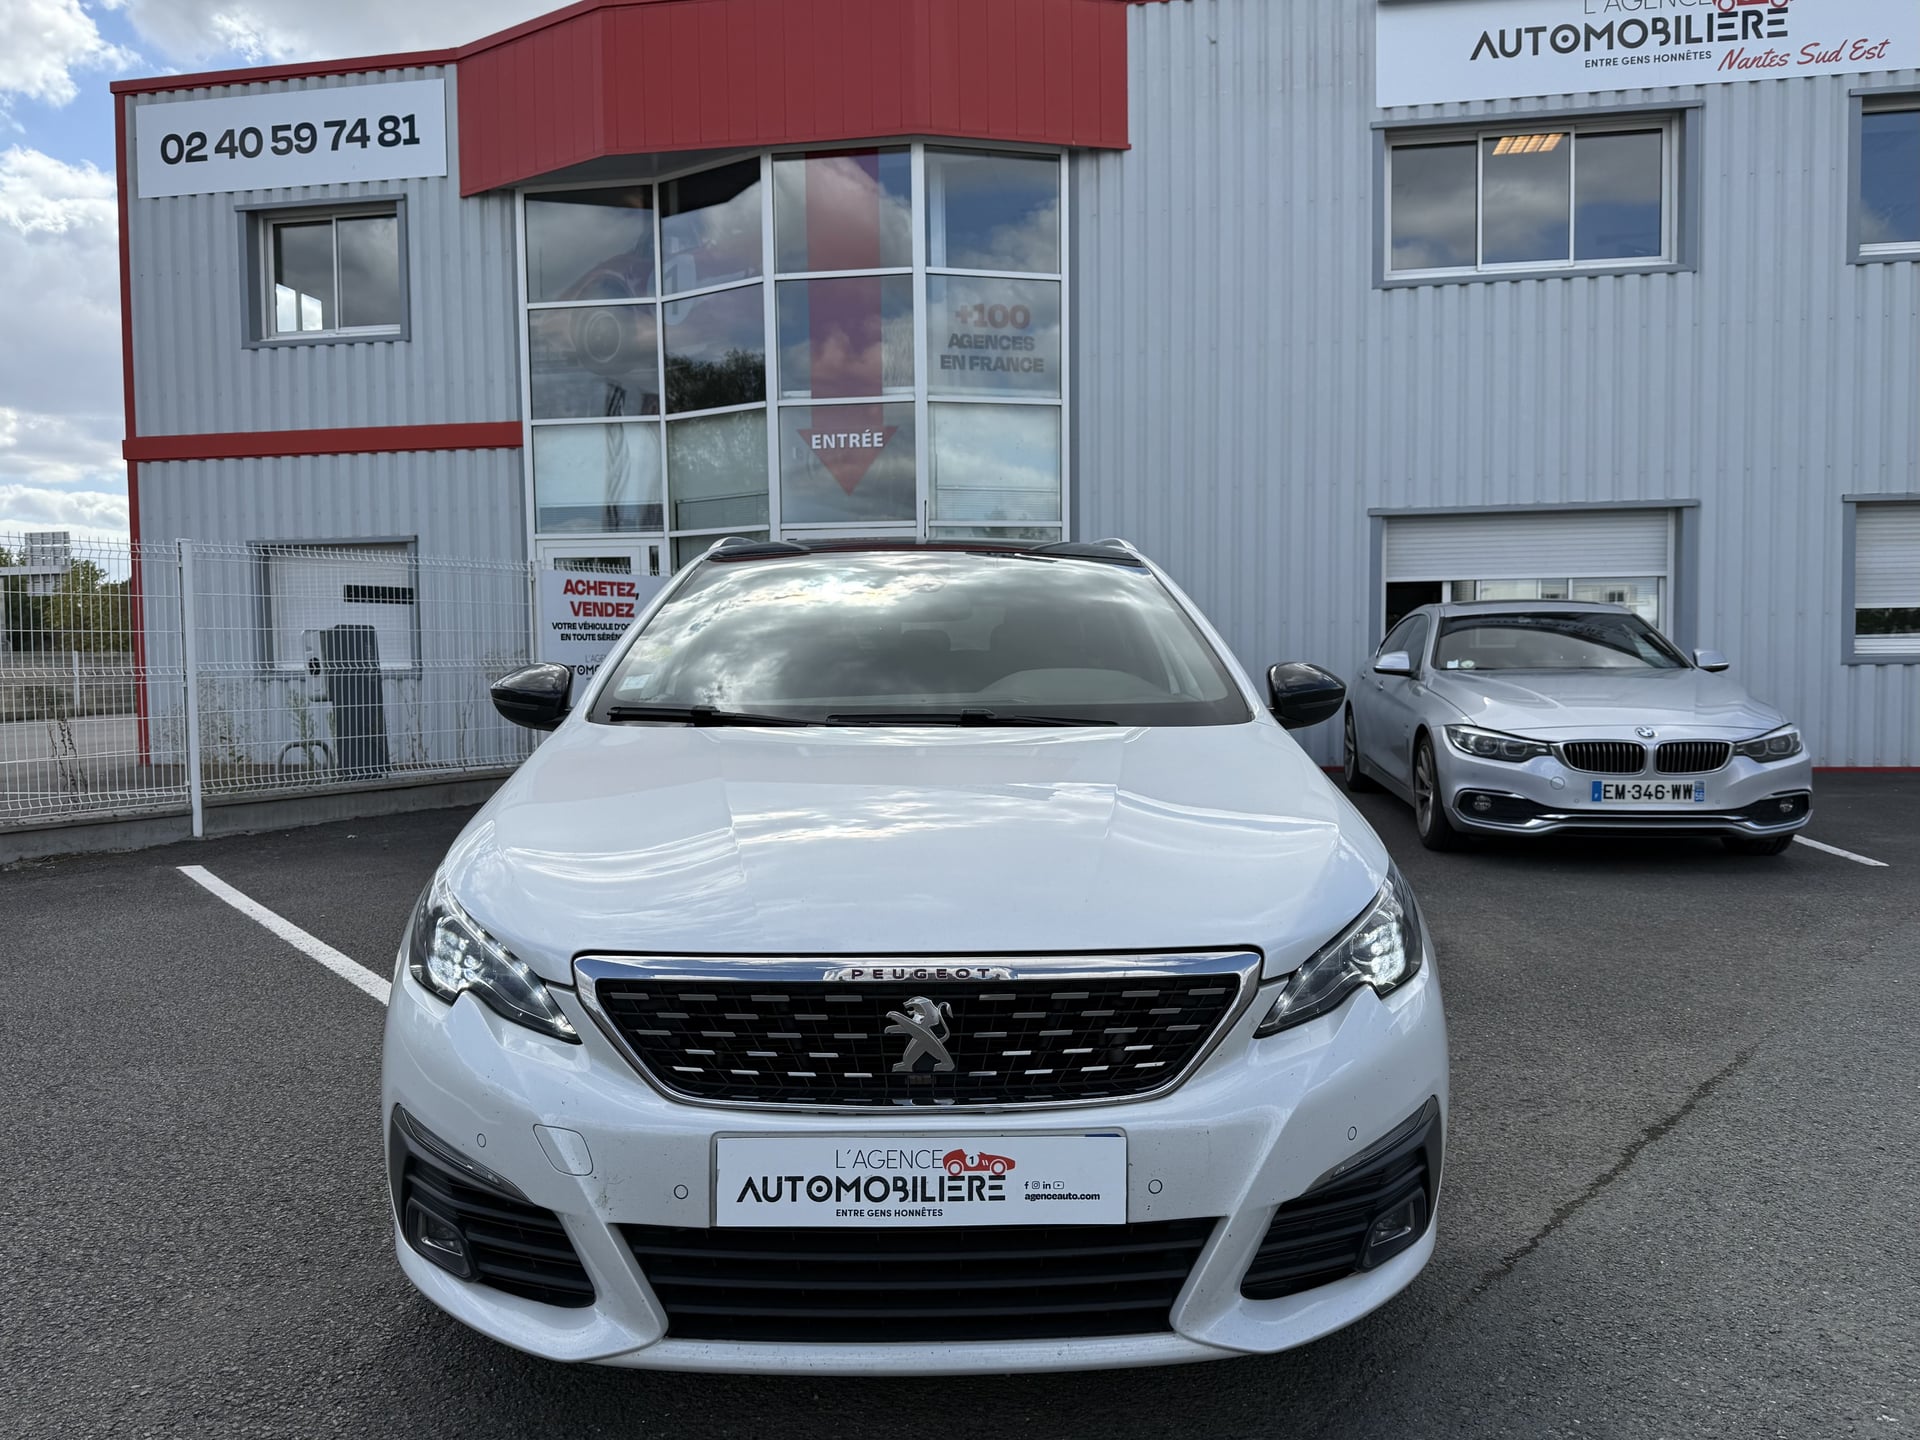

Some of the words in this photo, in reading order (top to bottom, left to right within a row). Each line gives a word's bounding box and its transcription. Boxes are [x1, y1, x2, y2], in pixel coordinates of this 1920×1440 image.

[1584, 57, 1619, 68] ENTRE
[1621, 55, 1650, 66] GENS
[1653, 50, 1712, 63] HONNÊTES
[1717, 47, 1790, 71] Nantes
[1796, 39, 1848, 65] Sud
[1848, 38, 1891, 61] Est
[160, 131, 208, 165] 02
[214, 126, 263, 160] 40
[270, 122, 318, 156] 59
[324, 118, 370, 151] 74
[378, 114, 420, 147] 81
[954, 303, 1031, 330] +100
[947, 333, 1036, 351] AGENCES
[940, 354, 966, 370] EN
[968, 355, 1045, 373] FRANCE
[811, 429, 884, 450] ENTRÉE
[563, 579, 640, 600] ACHETEZ,
[570, 600, 635, 618] VENDEZ
[552, 622, 577, 630] VOTRE
[577, 620, 613, 631] VÉHICULE
[560, 633, 571, 641] EN
[573, 633, 596, 641] TOUTE
[1603, 784, 1693, 800] EM-346-WW
[851, 968, 990, 980] PEUGEOT
[835, 1149, 943, 1170] L'AGENCE
[1024, 1192, 1100, 1202] agenceauto.com
[835, 1209, 865, 1217] ENTRE
[867, 1209, 892, 1217] GENS
[894, 1207, 943, 1217] HONNÊTES
